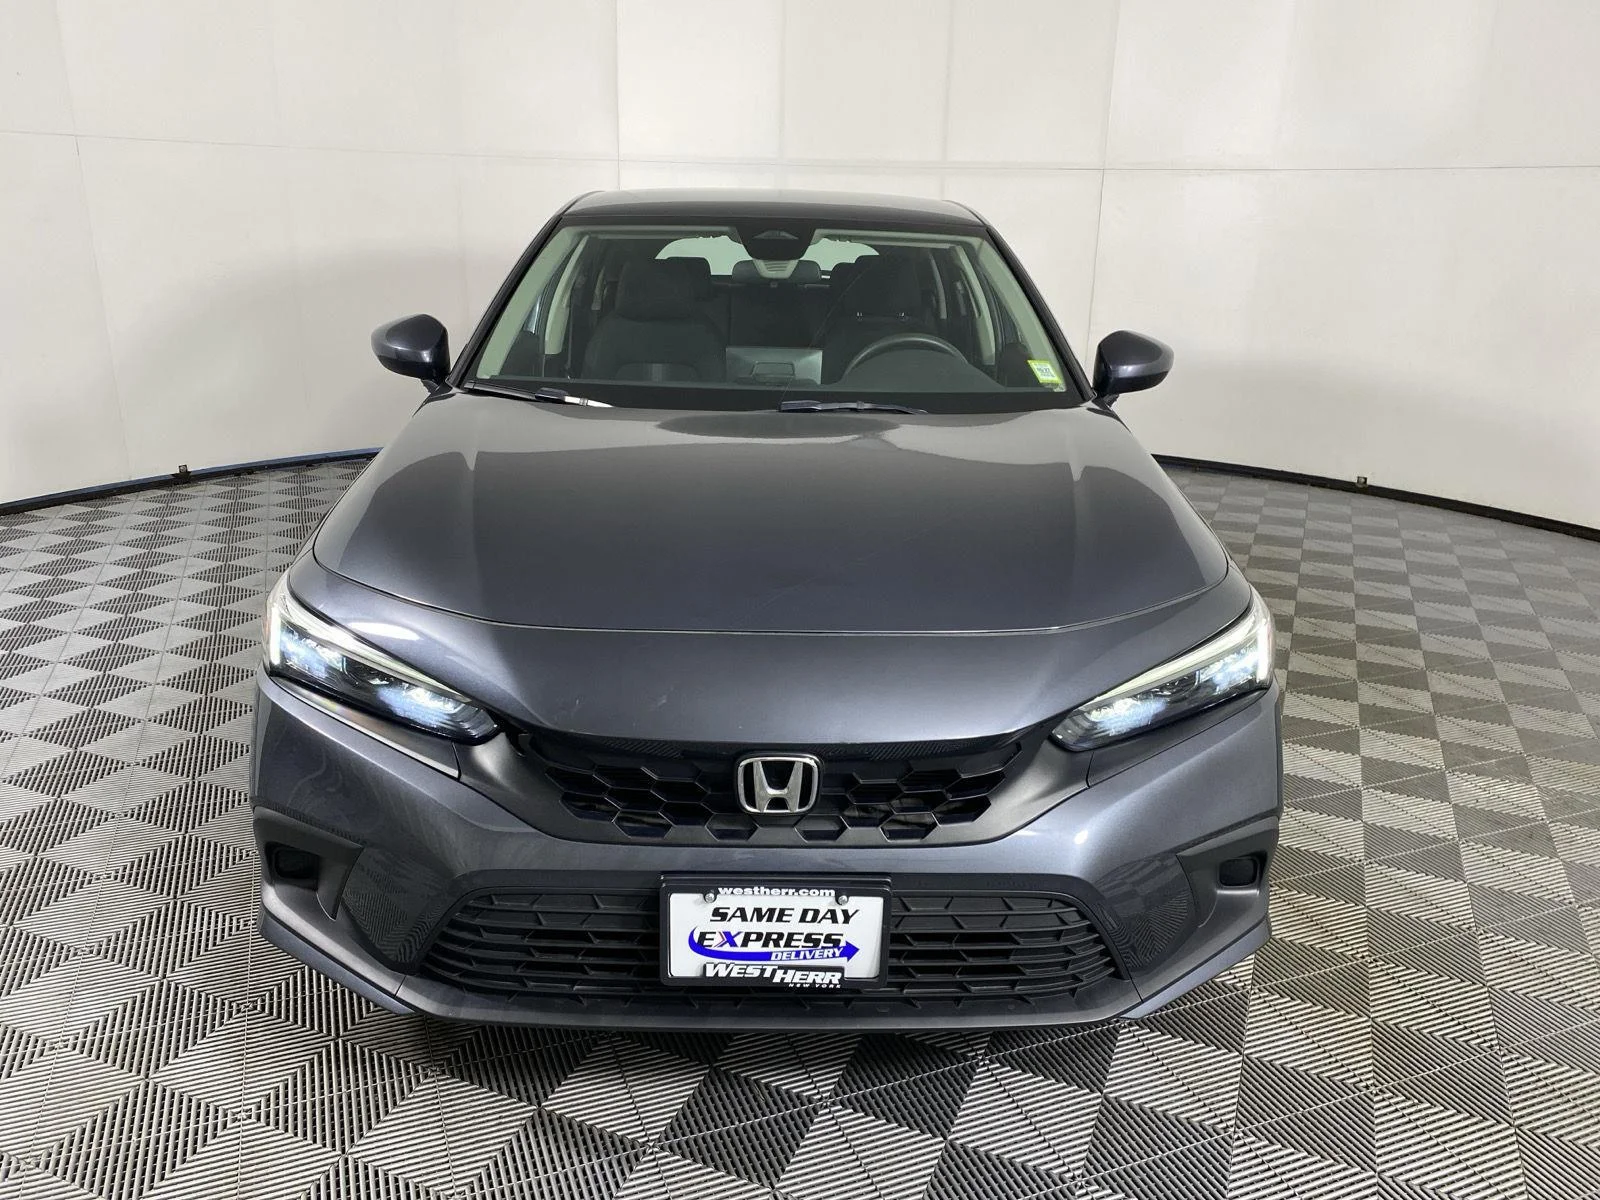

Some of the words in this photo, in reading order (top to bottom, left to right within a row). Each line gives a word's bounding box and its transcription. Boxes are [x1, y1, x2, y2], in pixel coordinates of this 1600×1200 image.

[718, 886, 836, 897] westherr.com
[710, 907, 795, 923] SAME
[799, 909, 860, 924] DAY
[697, 931, 844, 949] EXPRESS
[770, 948, 844, 961] DELIVERY
